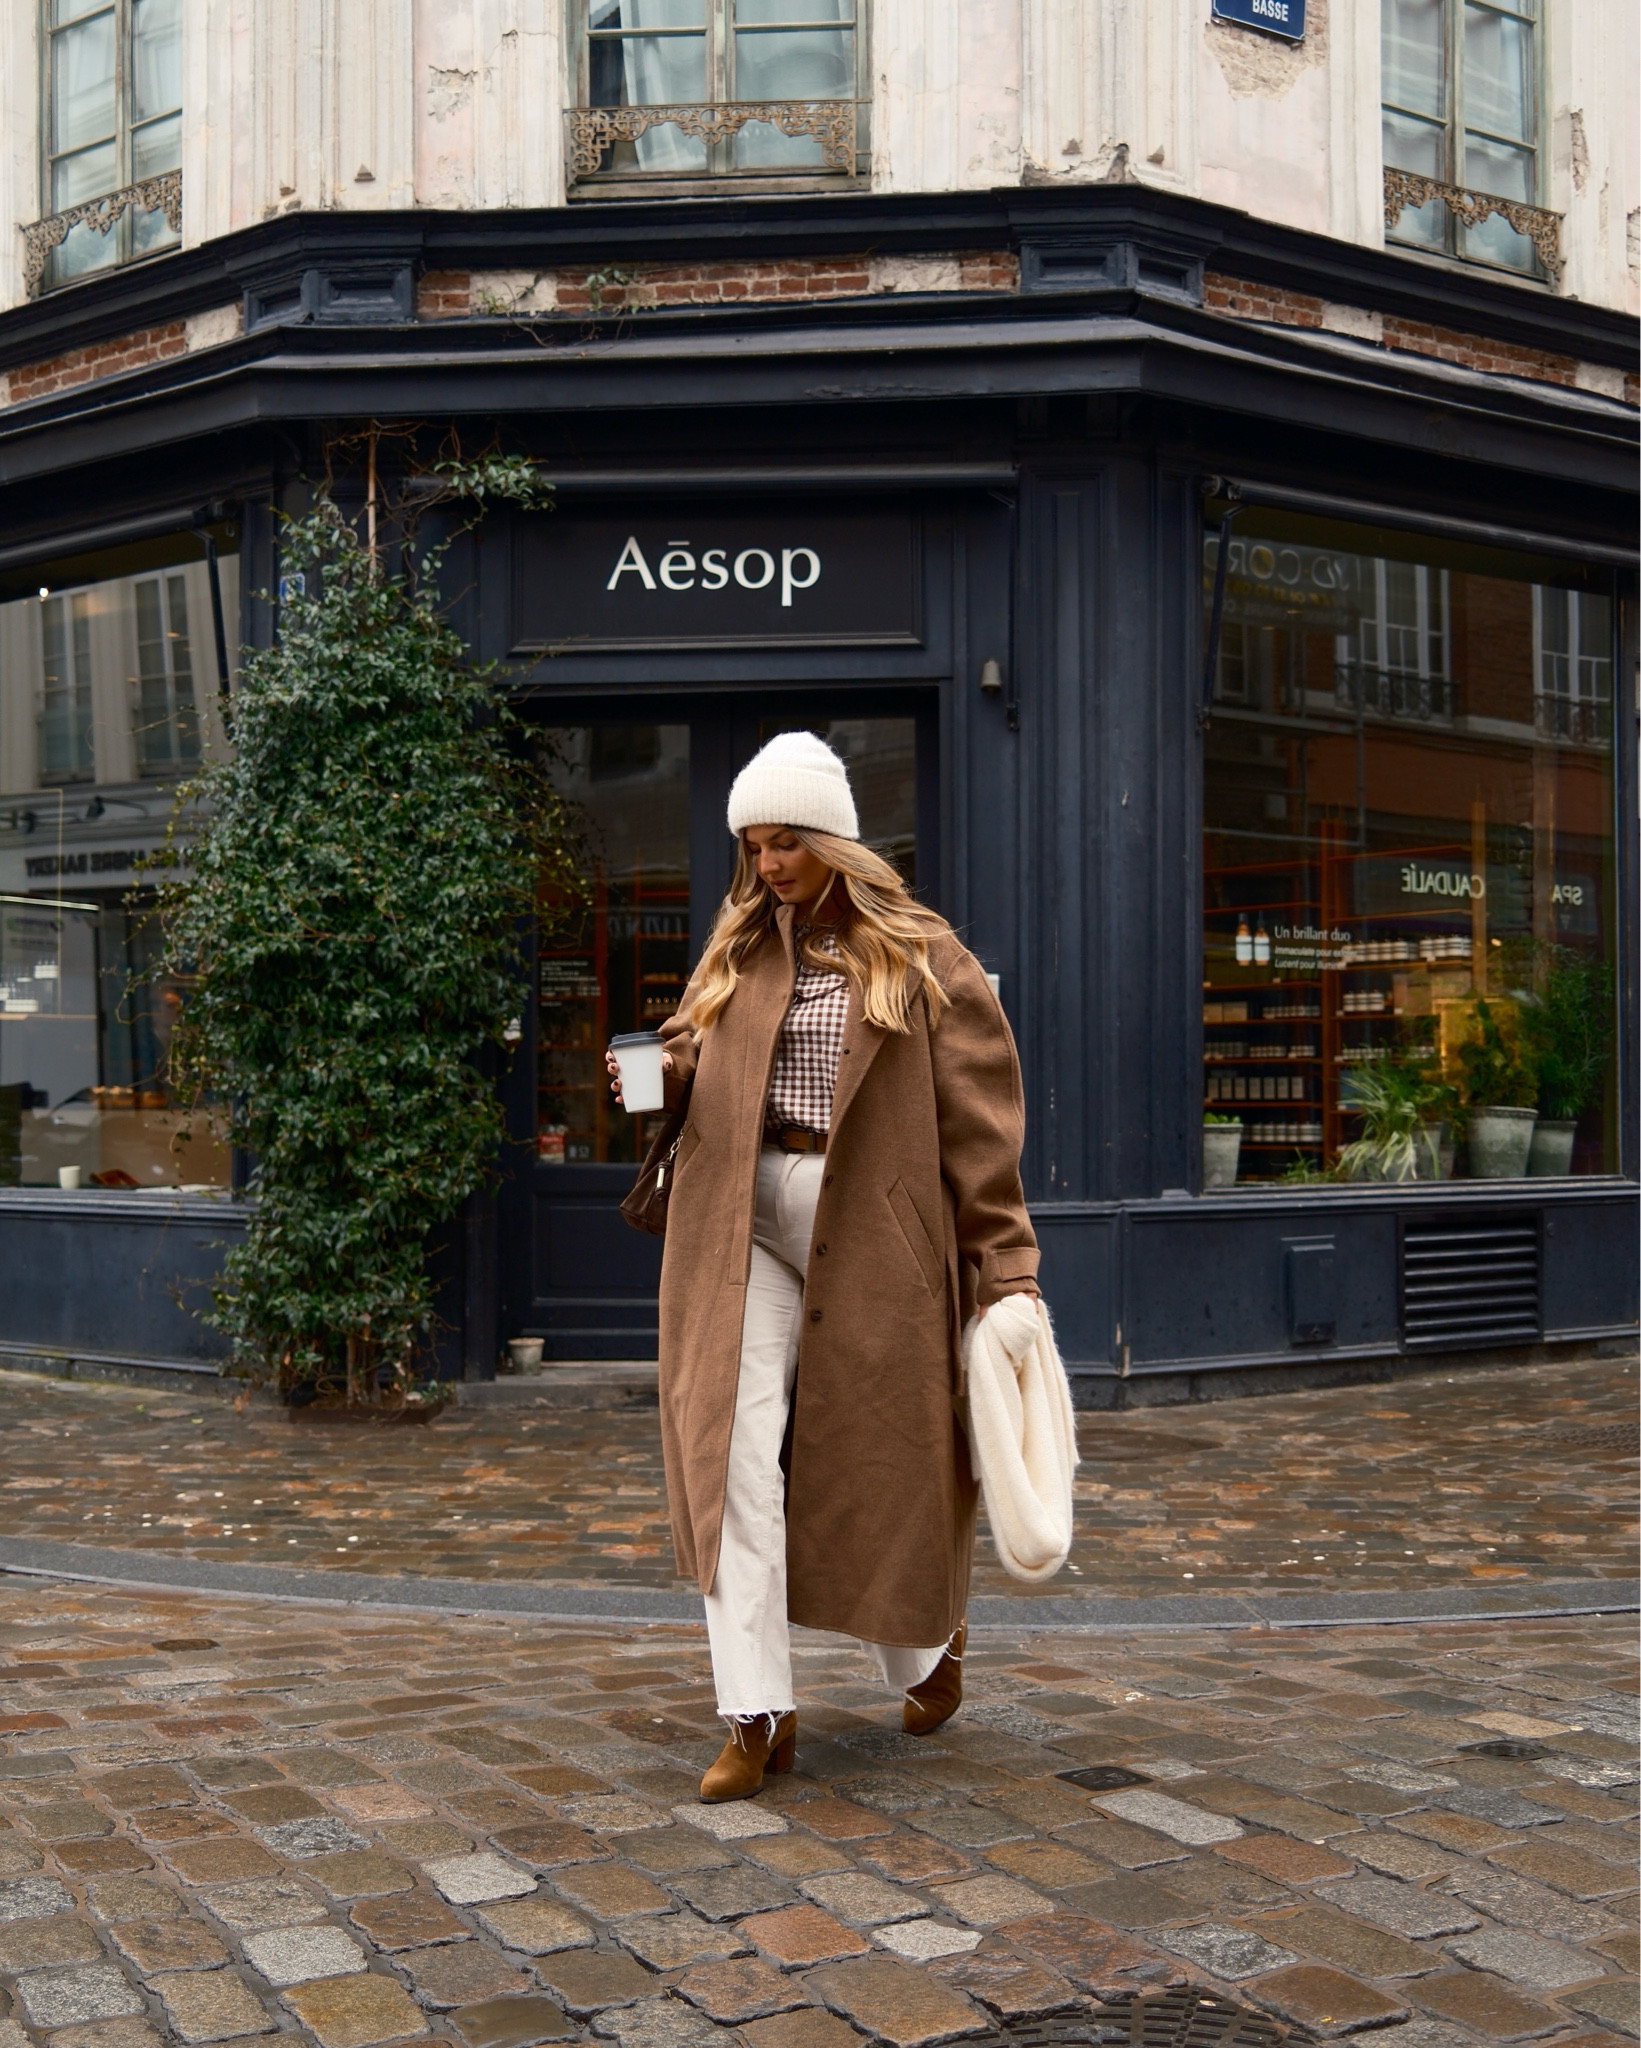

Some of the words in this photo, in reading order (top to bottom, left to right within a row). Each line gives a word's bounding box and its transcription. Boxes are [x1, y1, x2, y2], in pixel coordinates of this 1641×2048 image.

[1252, 0, 1289, 22] BASSE
[606, 536, 821, 607] Aēsop
[1274, 925, 1291, 939] Un
[1293, 925, 1329, 941] brillant
[1330, 927, 1351, 942] duo
[1300, 961, 1316, 970] pour
